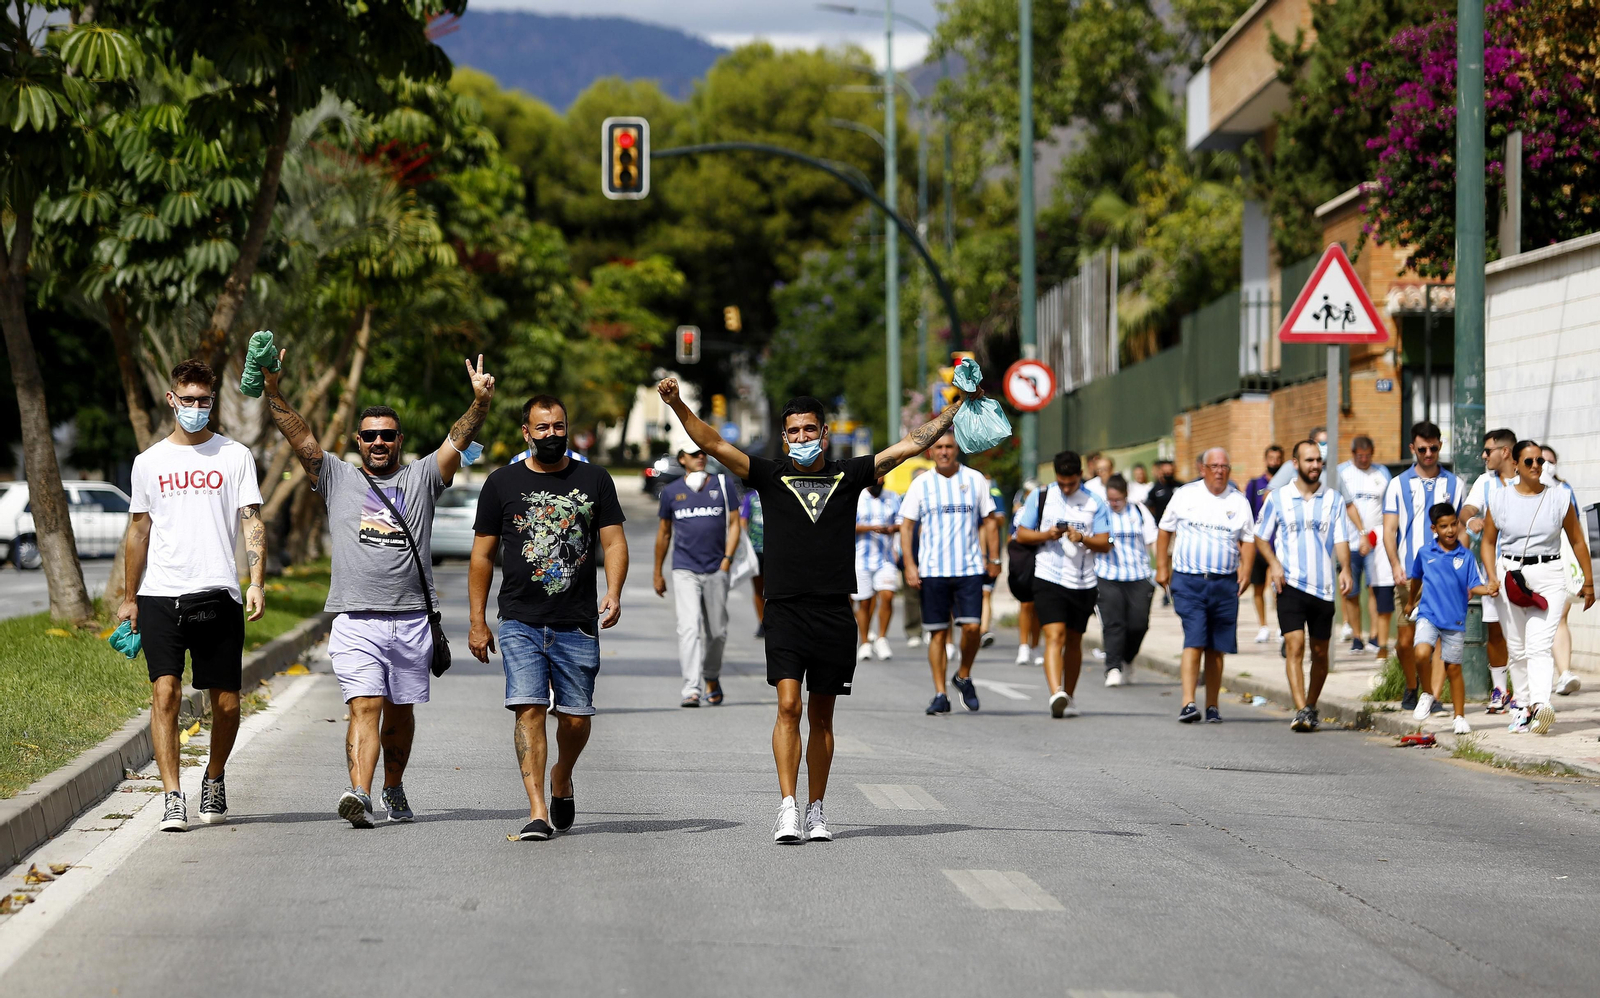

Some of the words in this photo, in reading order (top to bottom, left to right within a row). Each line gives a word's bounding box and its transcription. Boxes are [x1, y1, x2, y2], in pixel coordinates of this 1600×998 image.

[158, 470, 223, 492] HUGO
[794, 480, 834, 488] GUESS
[162, 490, 187, 498] HUGO
[187, 610, 217, 622] FILA
